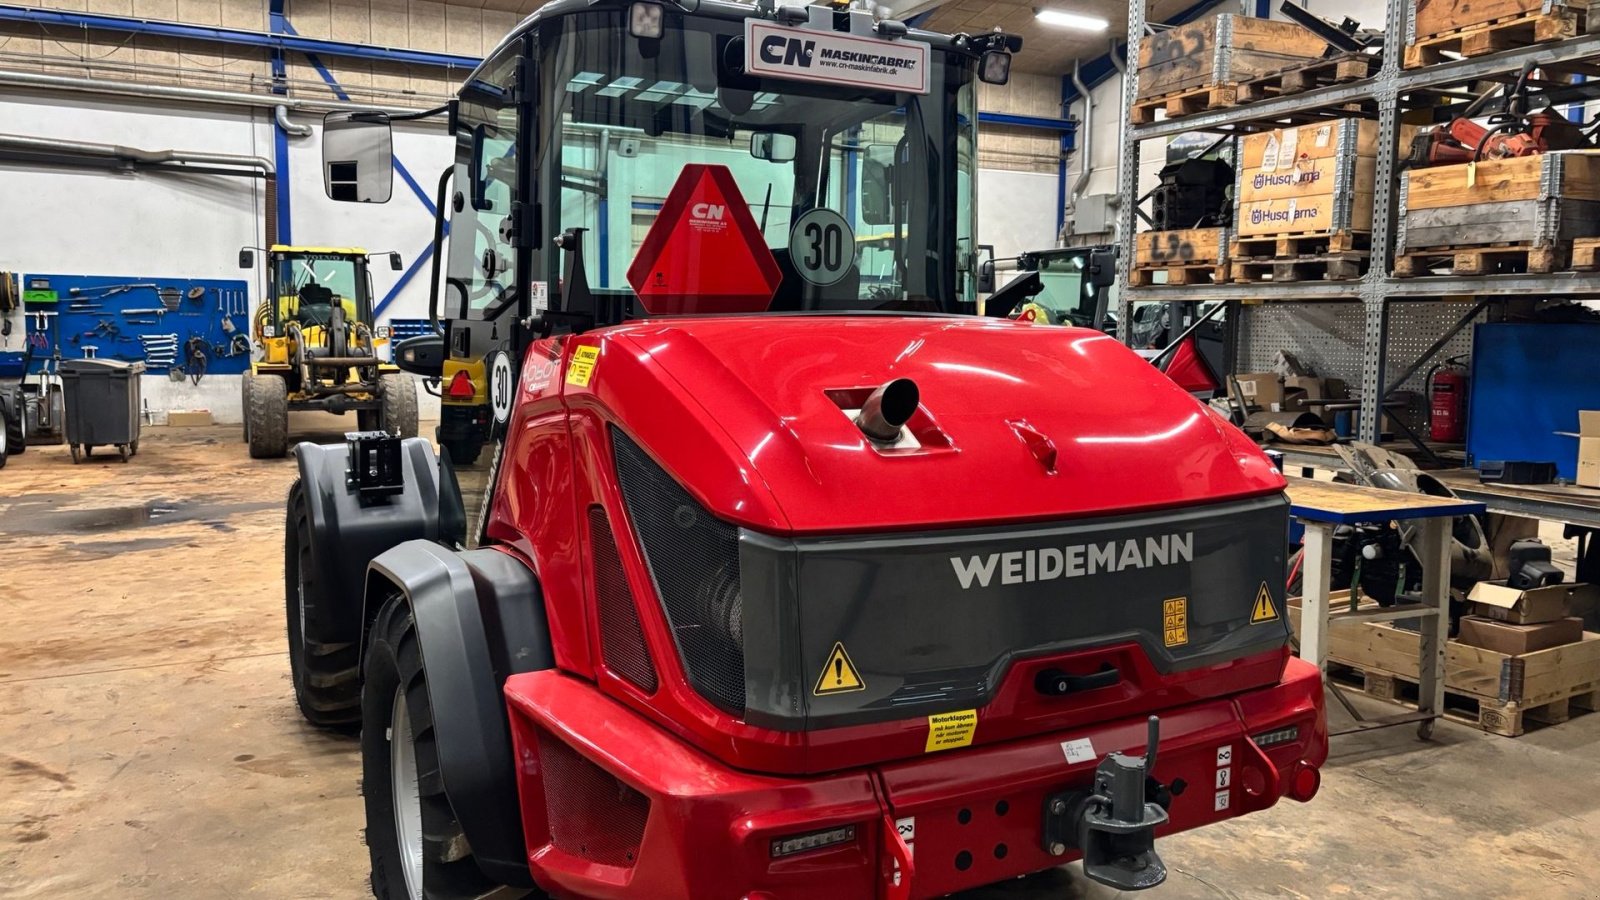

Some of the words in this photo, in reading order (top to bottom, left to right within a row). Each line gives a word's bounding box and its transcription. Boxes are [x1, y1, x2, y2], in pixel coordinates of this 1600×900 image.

[760, 35, 816, 68] CN
[820, 48, 917, 70] MASKINFABRIK
[819, 60, 898, 75] www.cn-maskinfabrik.dk
[691, 202, 725, 220] CN
[1262, 208, 1318, 222] Husqarna
[804, 222, 842, 272] 30
[495, 365, 508, 410] 30
[950, 532, 1194, 590] WEIDEMANN
[932, 714, 975, 723] Motorklappen
